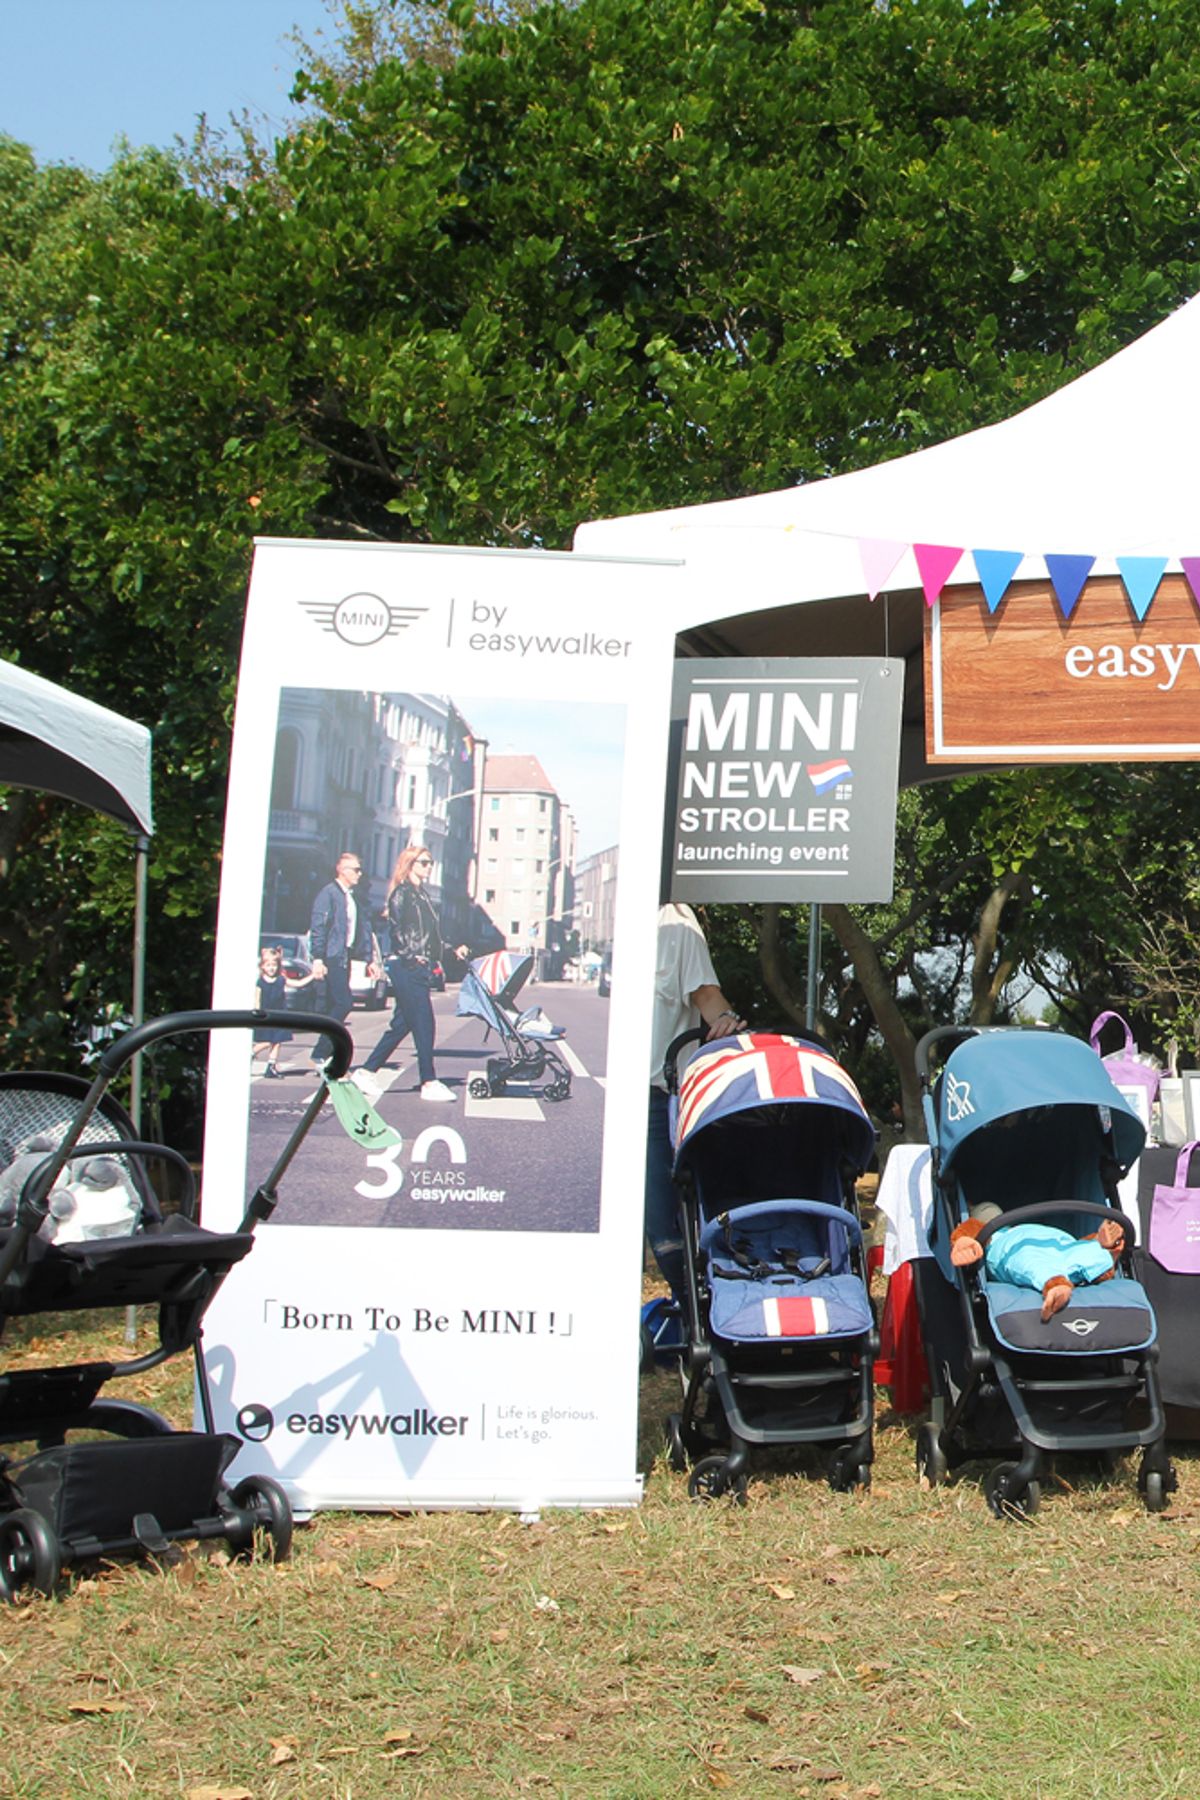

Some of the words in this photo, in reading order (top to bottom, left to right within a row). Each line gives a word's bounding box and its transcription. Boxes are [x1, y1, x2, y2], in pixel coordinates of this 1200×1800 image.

[341, 611, 384, 627] MINI
[470, 600, 508, 628] by
[468, 632, 633, 657] easywalker
[685, 692, 859, 752] MINI
[682, 761, 802, 799] NEW
[679, 807, 851, 833] STROLLER
[677, 842, 783, 866] launching
[789, 843, 850, 862] event
[410, 1171, 467, 1186] YEARS
[410, 1186, 506, 1205] easywalker
[364, 1307, 401, 1332] To
[412, 1308, 450, 1333] Be
[460, 1310, 538, 1335] MINI
[285, 1408, 470, 1441] easywalker
[497, 1405, 524, 1420] Life
[527, 1405, 538, 1420] is
[541, 1405, 599, 1425] glorious.
